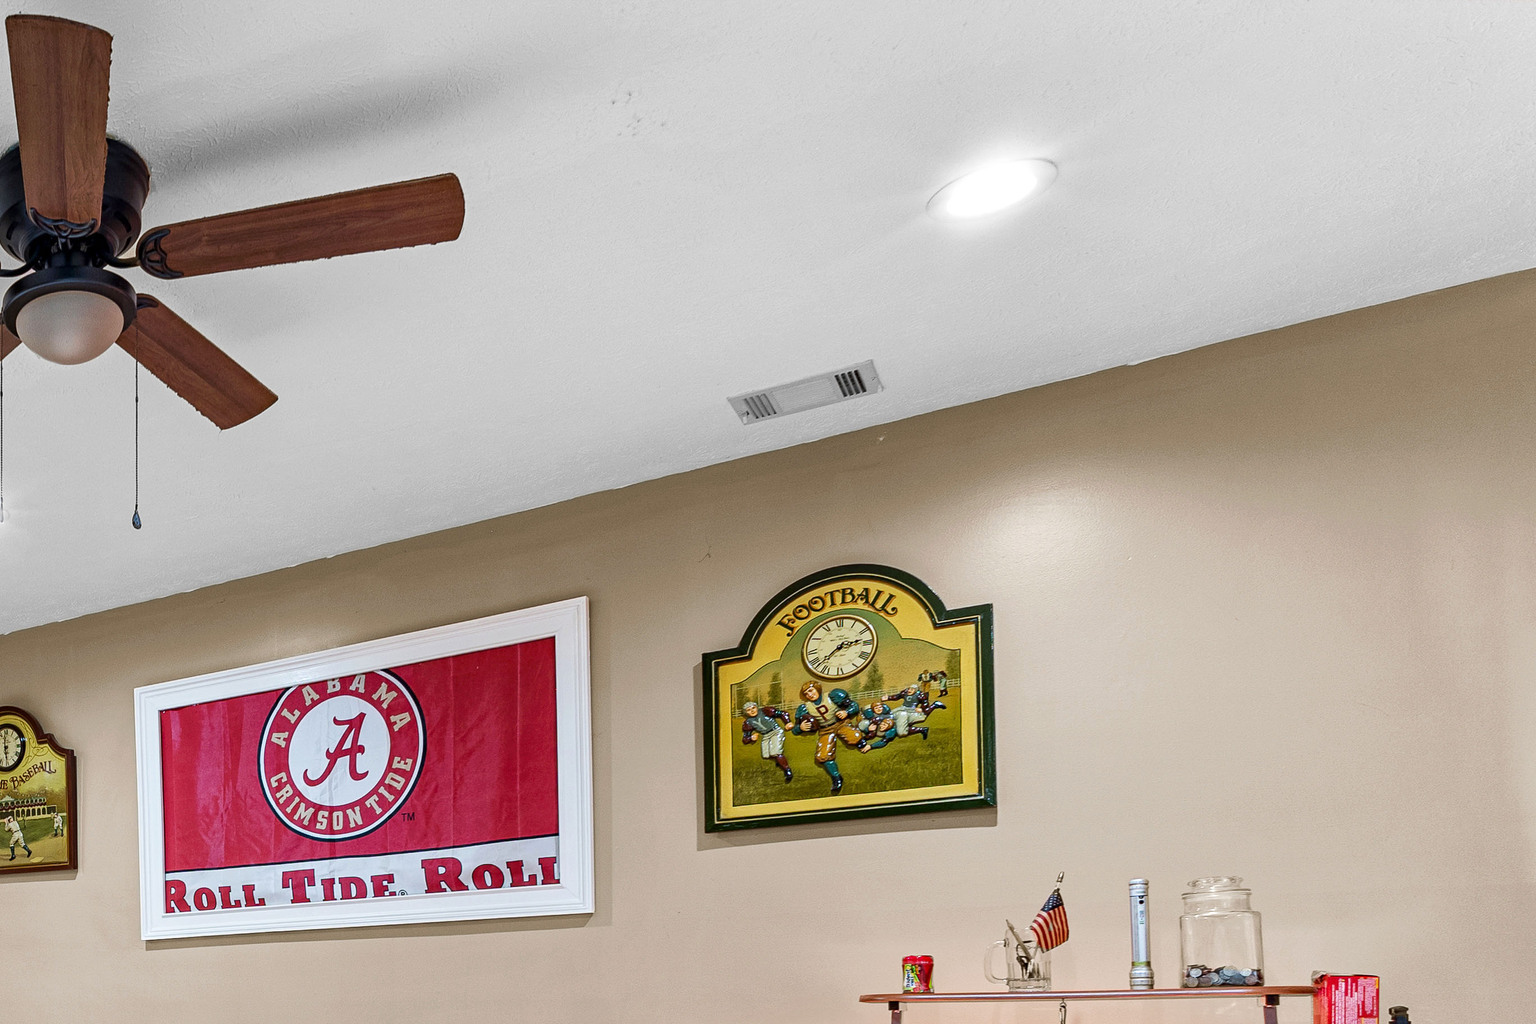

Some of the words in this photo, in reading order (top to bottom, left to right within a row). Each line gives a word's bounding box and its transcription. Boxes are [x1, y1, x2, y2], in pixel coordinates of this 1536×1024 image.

[775, 587, 898, 637] FOOTBALL
[269, 673, 411, 748] ALABAMA
[9, 761, 56, 789] BASEBALL
[303, 712, 368, 786] A
[270, 771, 362, 830] CRIMSON
[366, 756, 413, 813] TIDE
[166, 879, 265, 913] ROLL
[281, 868, 397, 904] TIDE
[421, 855, 560, 894] ROLL
